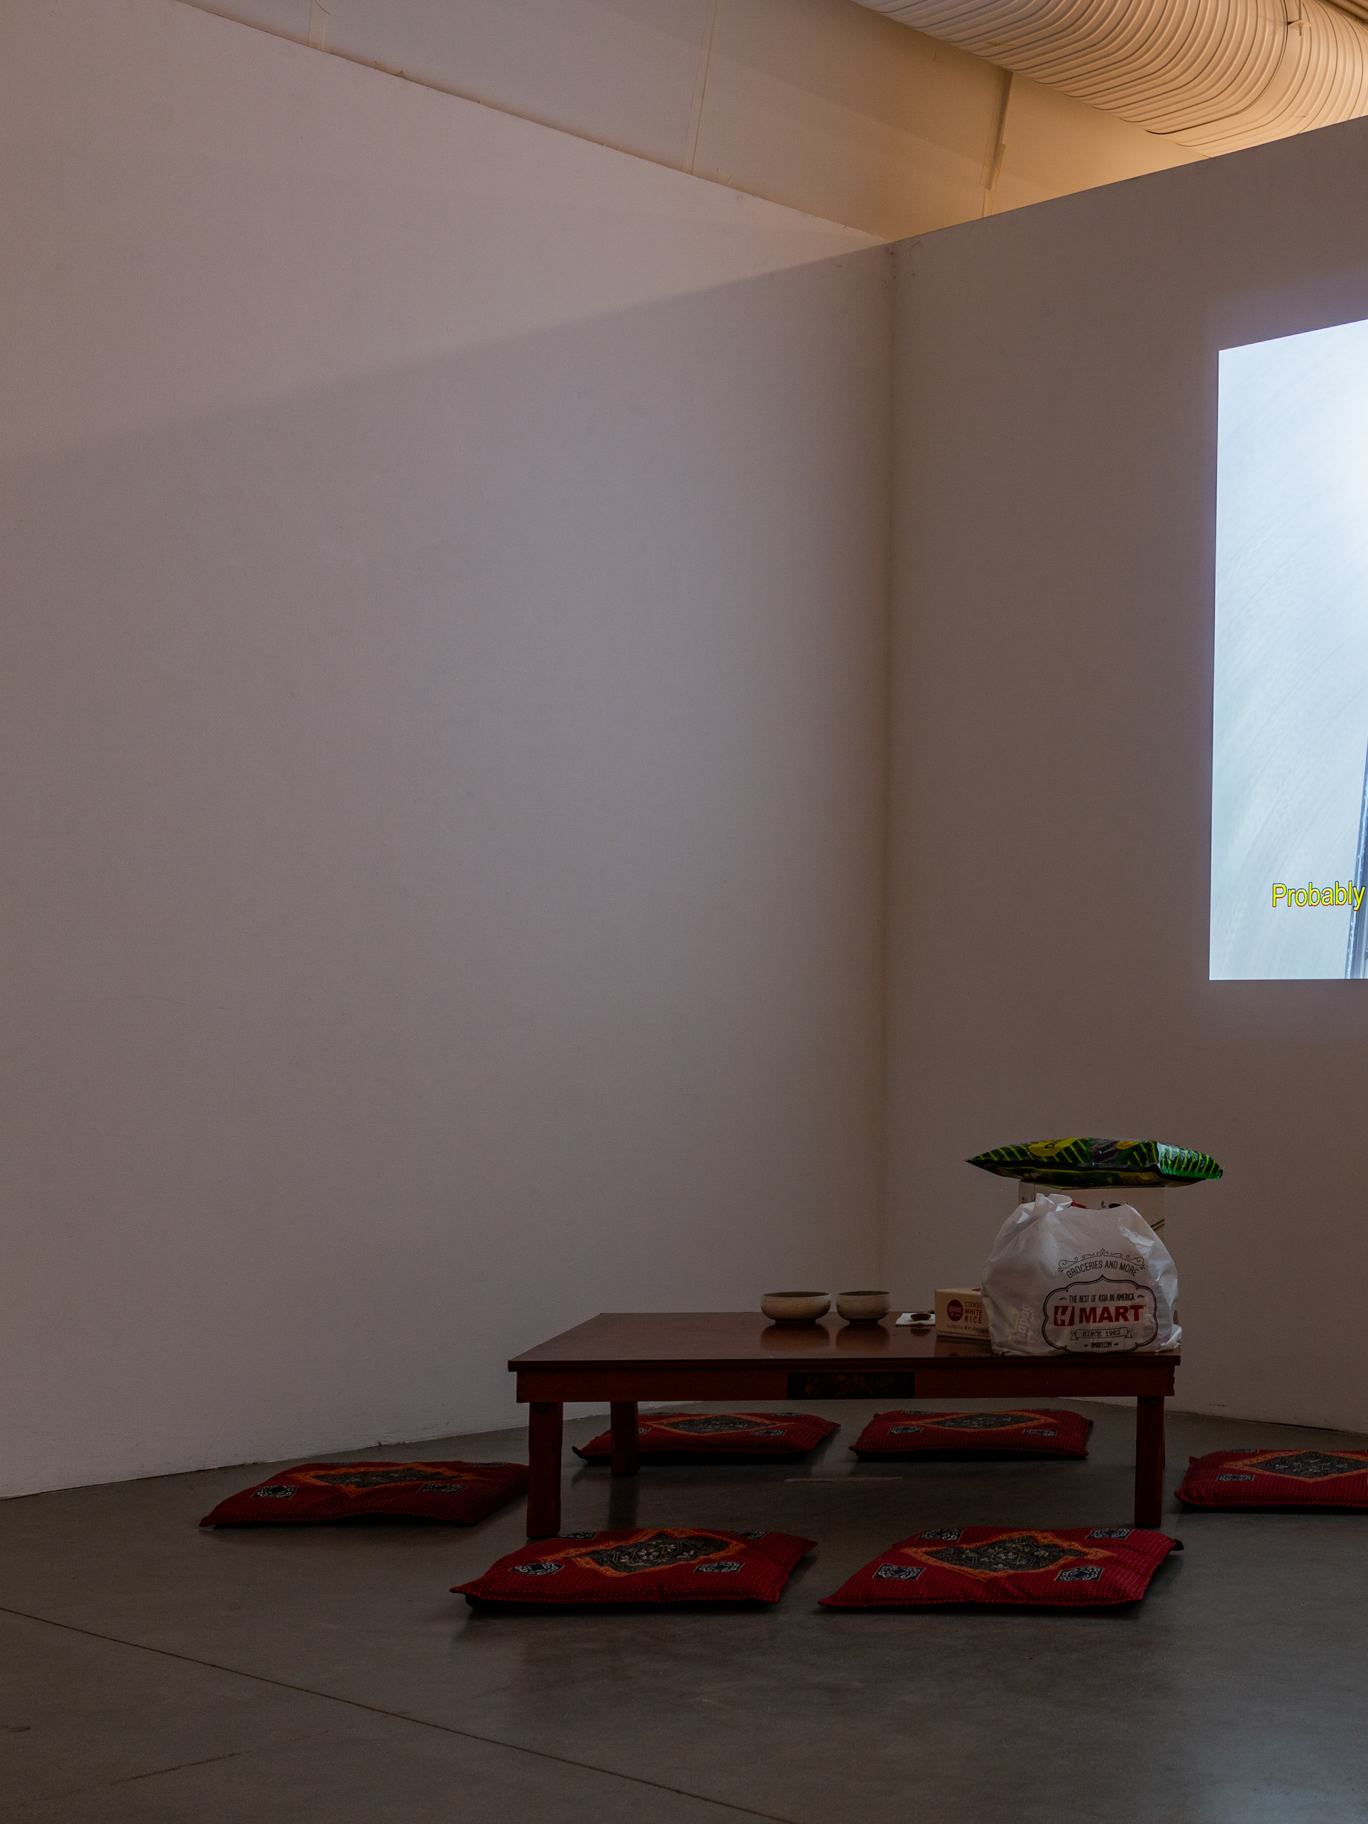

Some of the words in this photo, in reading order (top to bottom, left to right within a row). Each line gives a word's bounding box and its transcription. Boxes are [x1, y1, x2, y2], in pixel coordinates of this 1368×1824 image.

[1272, 881, 1365, 911] Probably
[1066, 1260, 1103, 1279] GROCERIES
[1105, 1260, 1118, 1270] AND
[1120, 1262, 1139, 1277] MORE
[1069, 1295, 1077, 1303] THE
[1079, 1295, 1090, 1303] BEST
[1091, 1295, 1096, 1303] OF
[1098, 1294, 1108, 1302] ASIA
[1110, 1294, 1115, 1302] IN
[964, 1301, 983, 1309] COOKED
[964, 1308, 983, 1317] WHITE
[1079, 1305, 1144, 1324] MART
[964, 1315, 982, 1324] RICE
[1106, 1329, 1121, 1337] 1982
